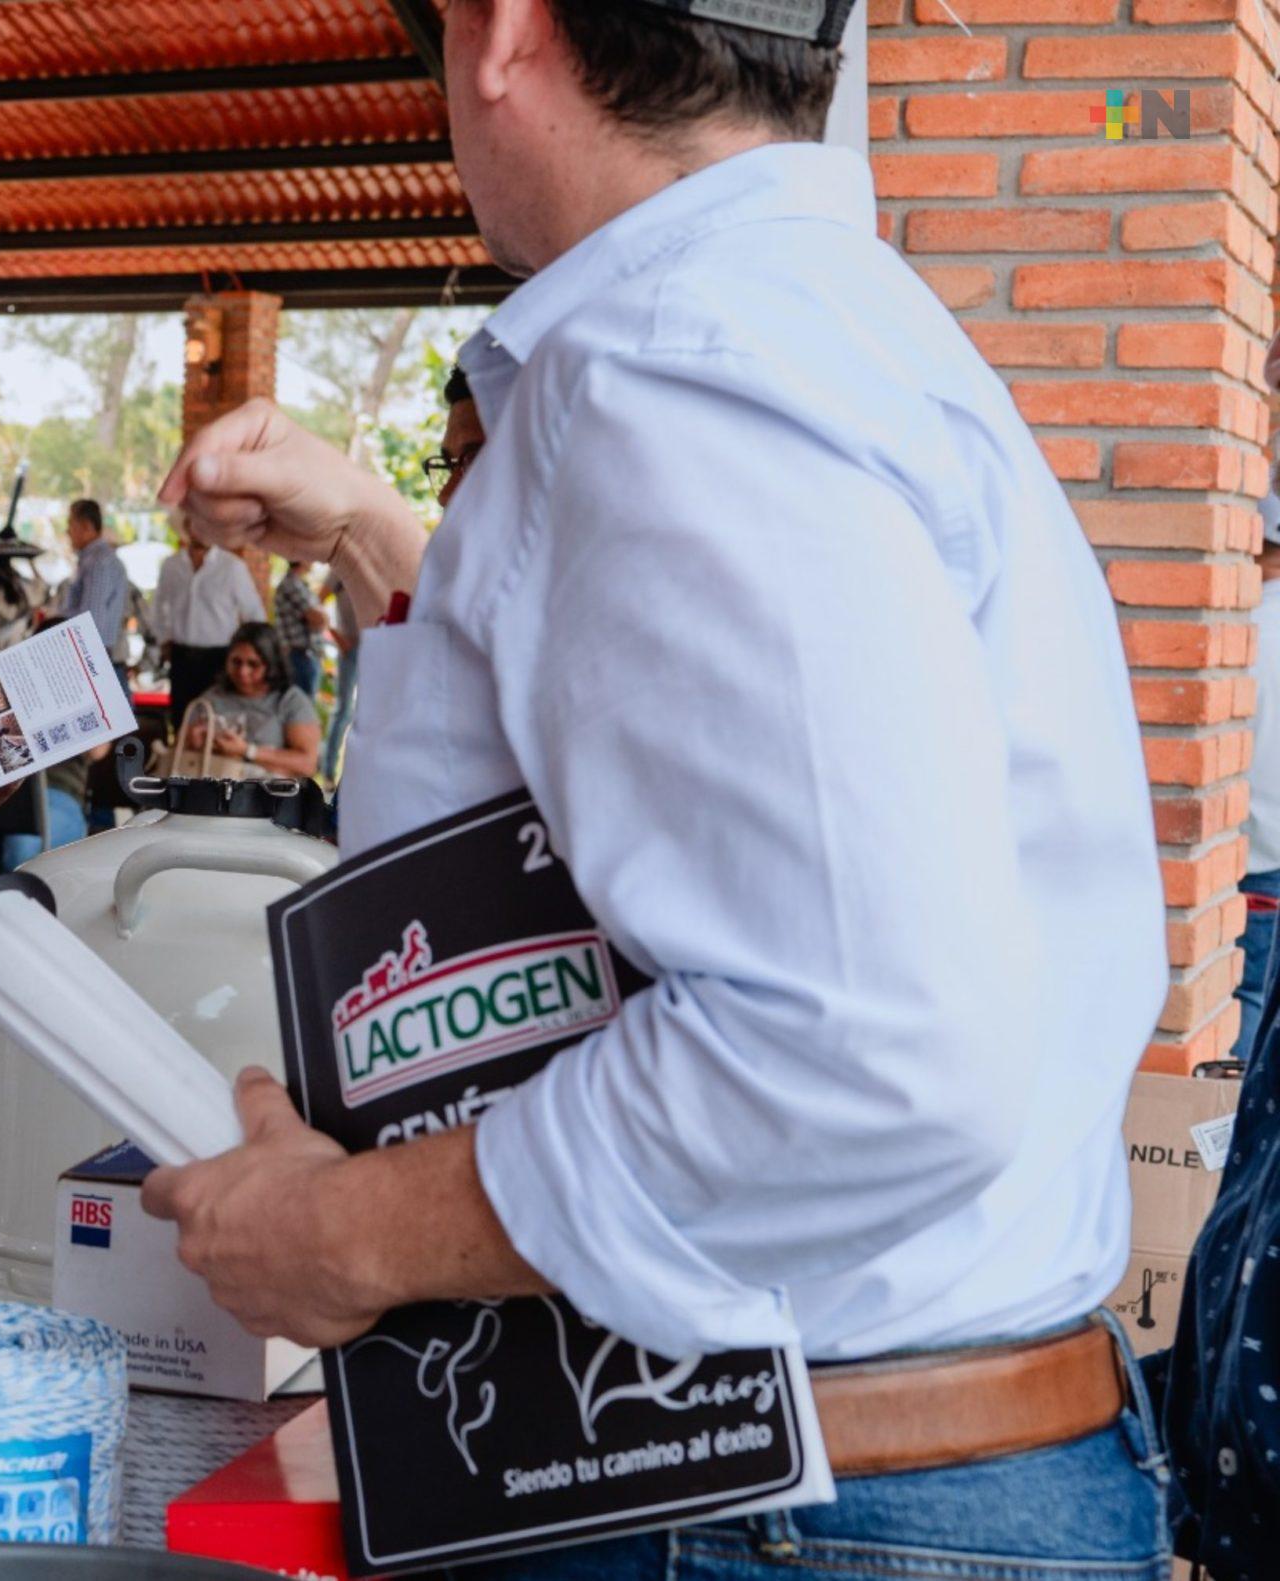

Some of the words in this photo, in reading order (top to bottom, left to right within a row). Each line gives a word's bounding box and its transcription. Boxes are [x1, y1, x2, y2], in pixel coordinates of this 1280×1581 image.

[343, 948, 604, 1083] LACTOGEN
[70, 1199, 113, 1228] ABS
[118, 1329, 150, 1347] ade
[155, 1333, 170, 1349] in
[175, 1337, 207, 1354] USA
[503, 1460, 573, 1498] Siendo
[575, 1456, 600, 1483] tu
[602, 1440, 685, 1478] camino
[687, 1429, 711, 1462] al
[714, 1422, 774, 1456] éxito
